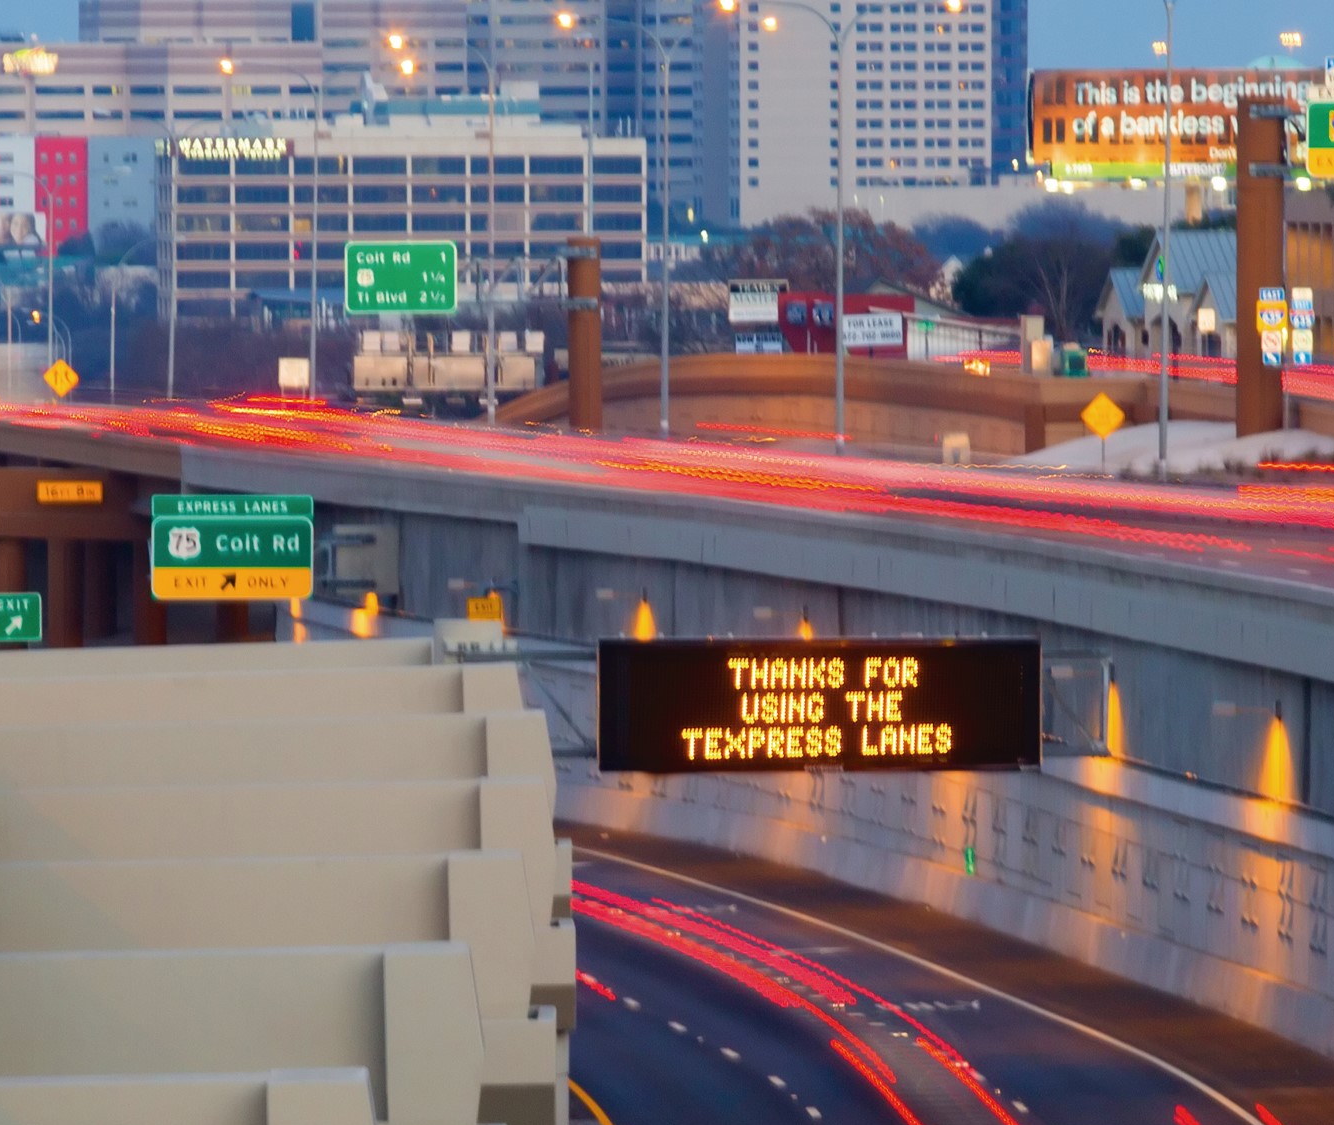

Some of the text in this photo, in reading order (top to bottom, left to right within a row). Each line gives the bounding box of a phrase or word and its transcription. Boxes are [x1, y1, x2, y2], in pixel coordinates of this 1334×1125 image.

[1075, 75, 1314, 108] This is the beginning
[1072, 110, 1096, 135] of
[1100, 115, 1114, 136] a
[1120, 110, 1225, 136] bankless
[179, 137, 287, 151] WATERMARK
[356, 251, 385, 264] Coit
[392, 251, 411, 264] Rd
[375, 291, 407, 304] Blvd
[848, 318, 894, 329] FOR LEASE
[177, 500, 288, 513] EXPRESS LANES
[171, 532, 300, 552] 75 Coit Rd
[174, 576, 289, 589] EXIT ONLY
[728, 656, 919, 690] THANKS FOR
[741, 690, 903, 724] USING THE
[681, 722, 953, 761] TEXPRESS LANES
